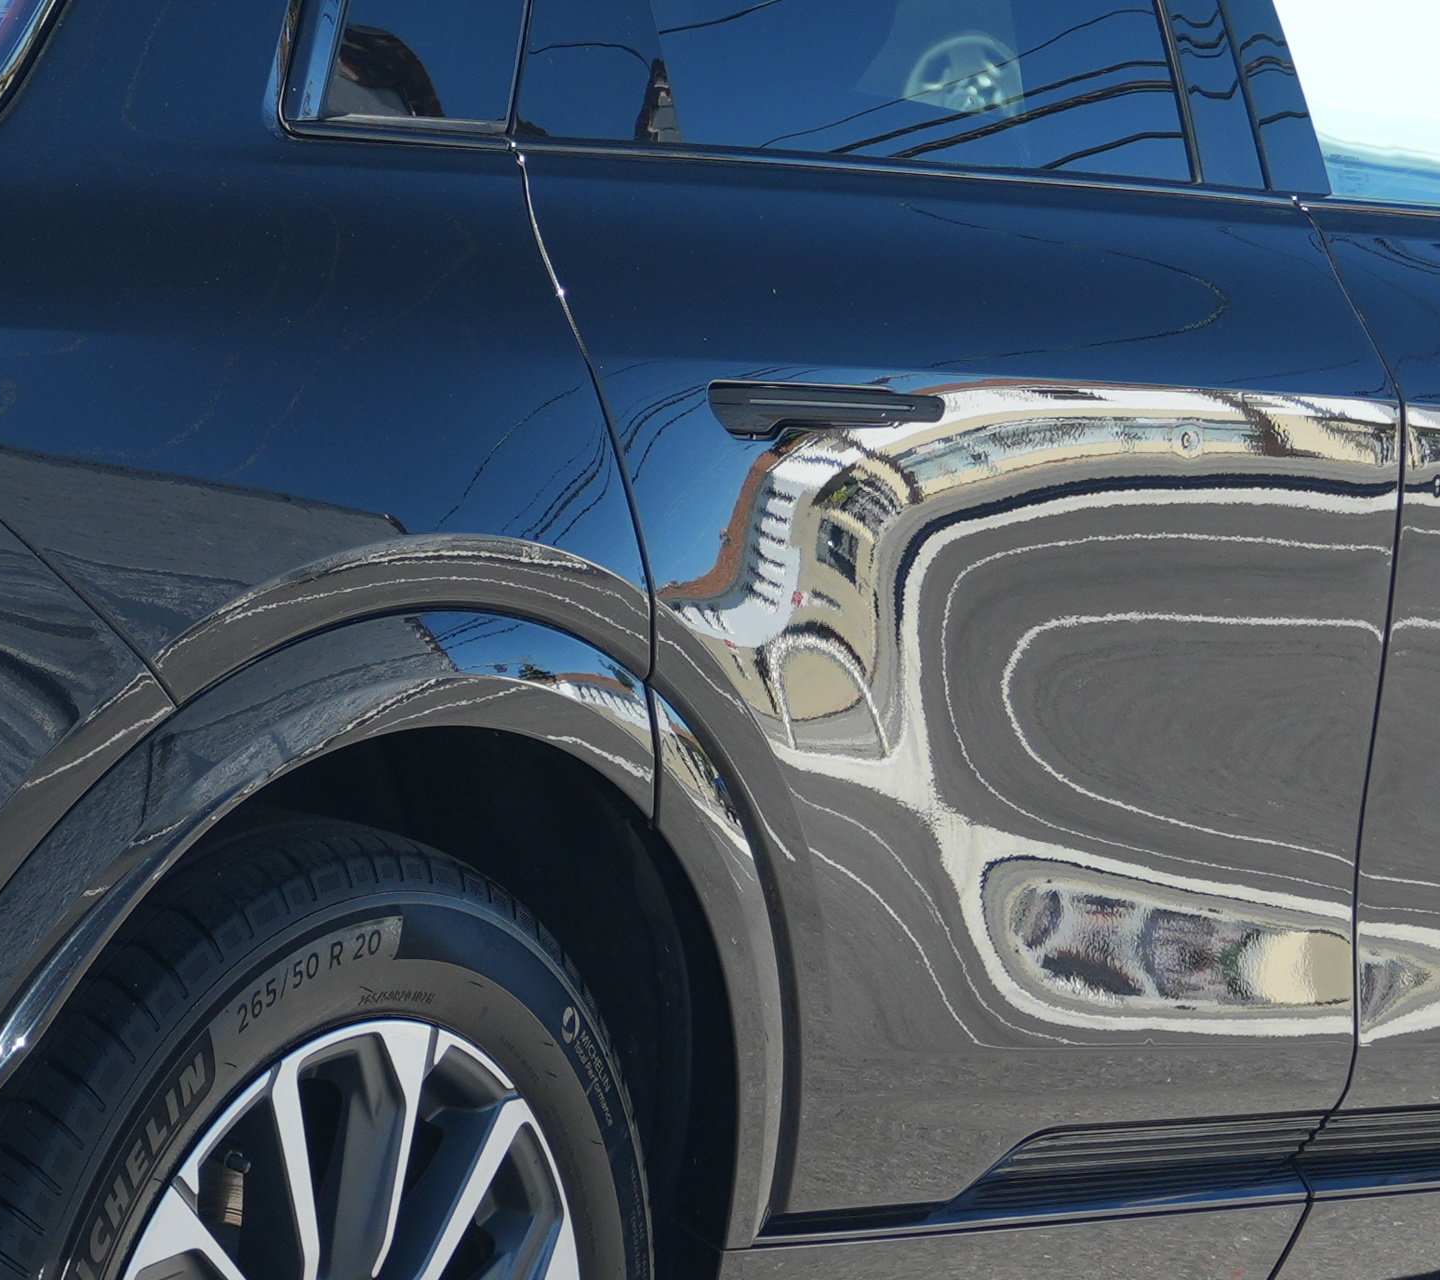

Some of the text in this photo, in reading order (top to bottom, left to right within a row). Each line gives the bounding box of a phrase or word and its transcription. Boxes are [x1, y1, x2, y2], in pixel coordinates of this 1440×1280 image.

[236, 929, 382, 1035] 265/50 R 20
[579, 1029, 612, 1094] MICHELIN
